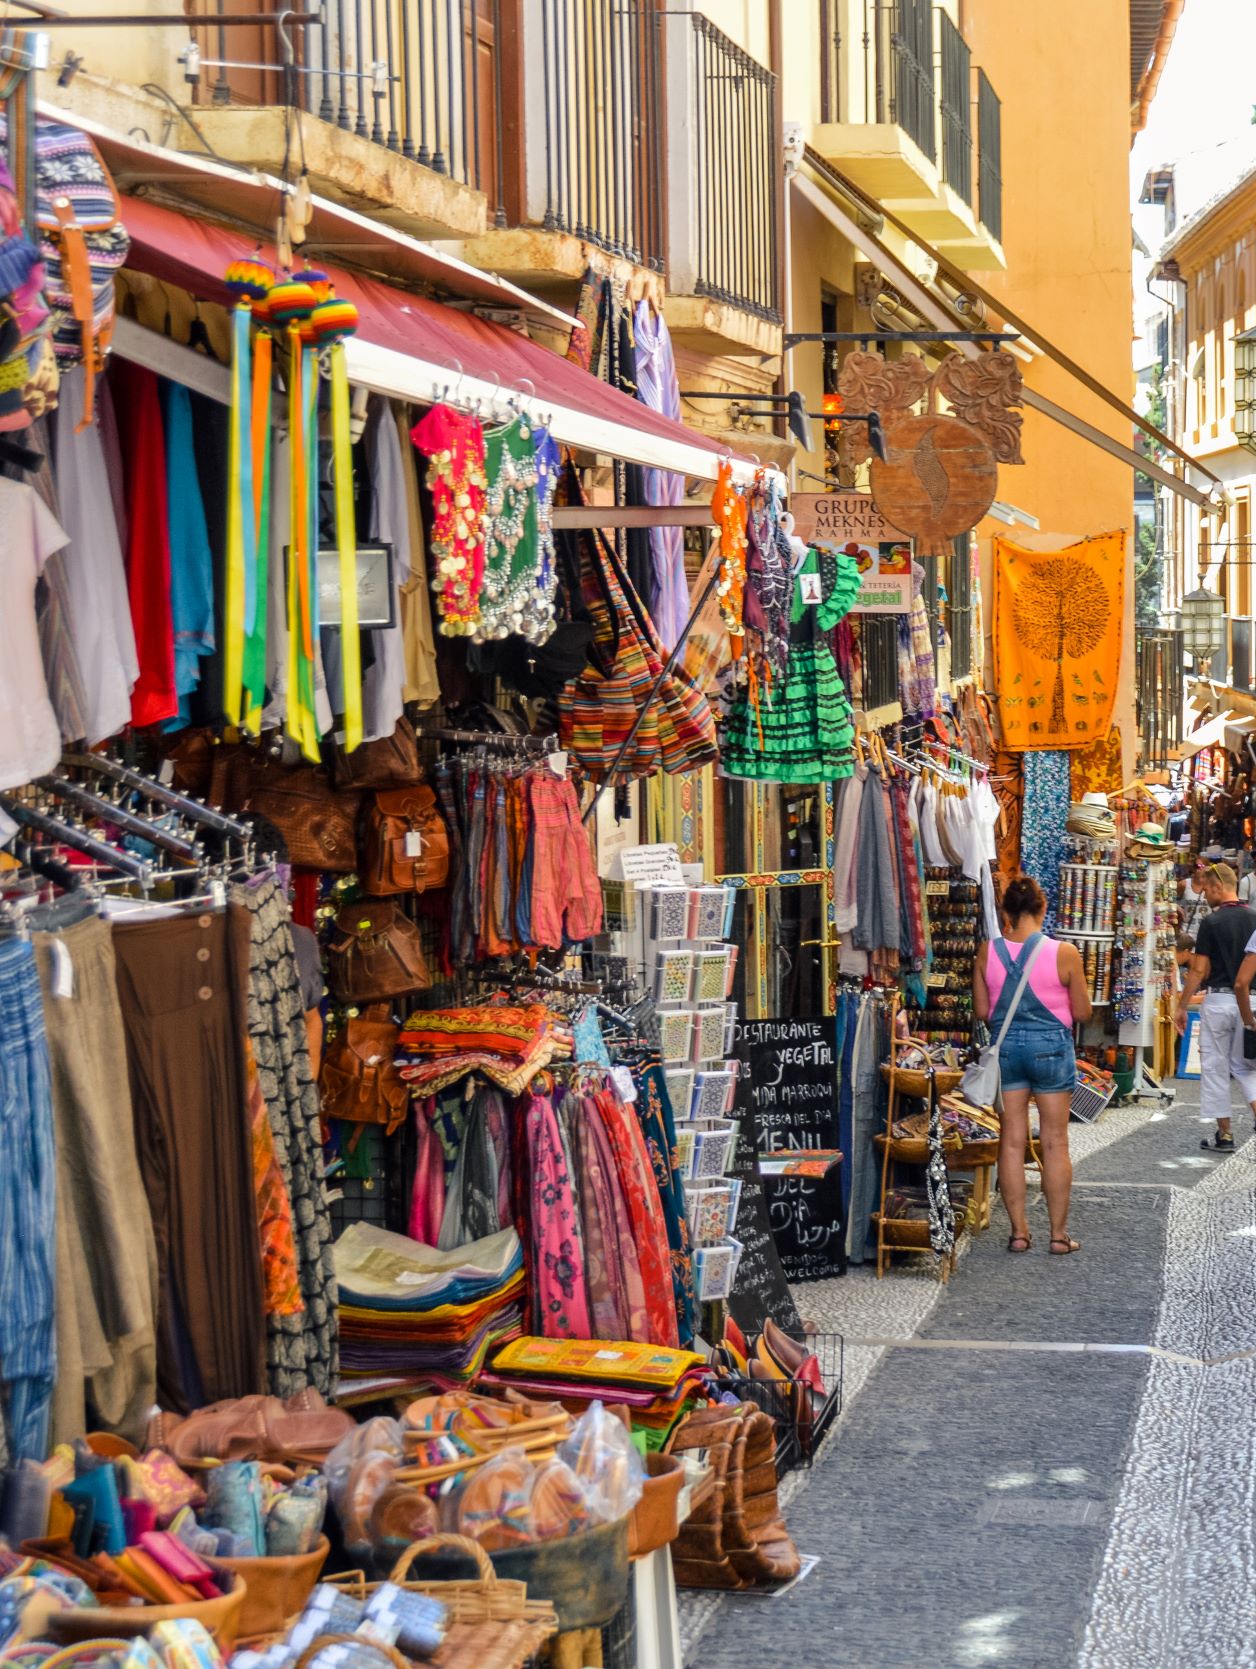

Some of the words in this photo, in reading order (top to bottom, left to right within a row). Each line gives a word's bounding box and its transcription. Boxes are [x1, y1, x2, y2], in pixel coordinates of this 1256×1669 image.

[816, 515, 885, 528] MEKNES
[815, 528, 886, 537] RAHMA
[856, 590, 903, 606] egetal
[776, 1041, 834, 1067] VEGETAL
[794, 1113, 811, 1126] DEL
[780, 1254, 828, 1266] VENIDOS
[784, 1263, 840, 1278] WELCOME
